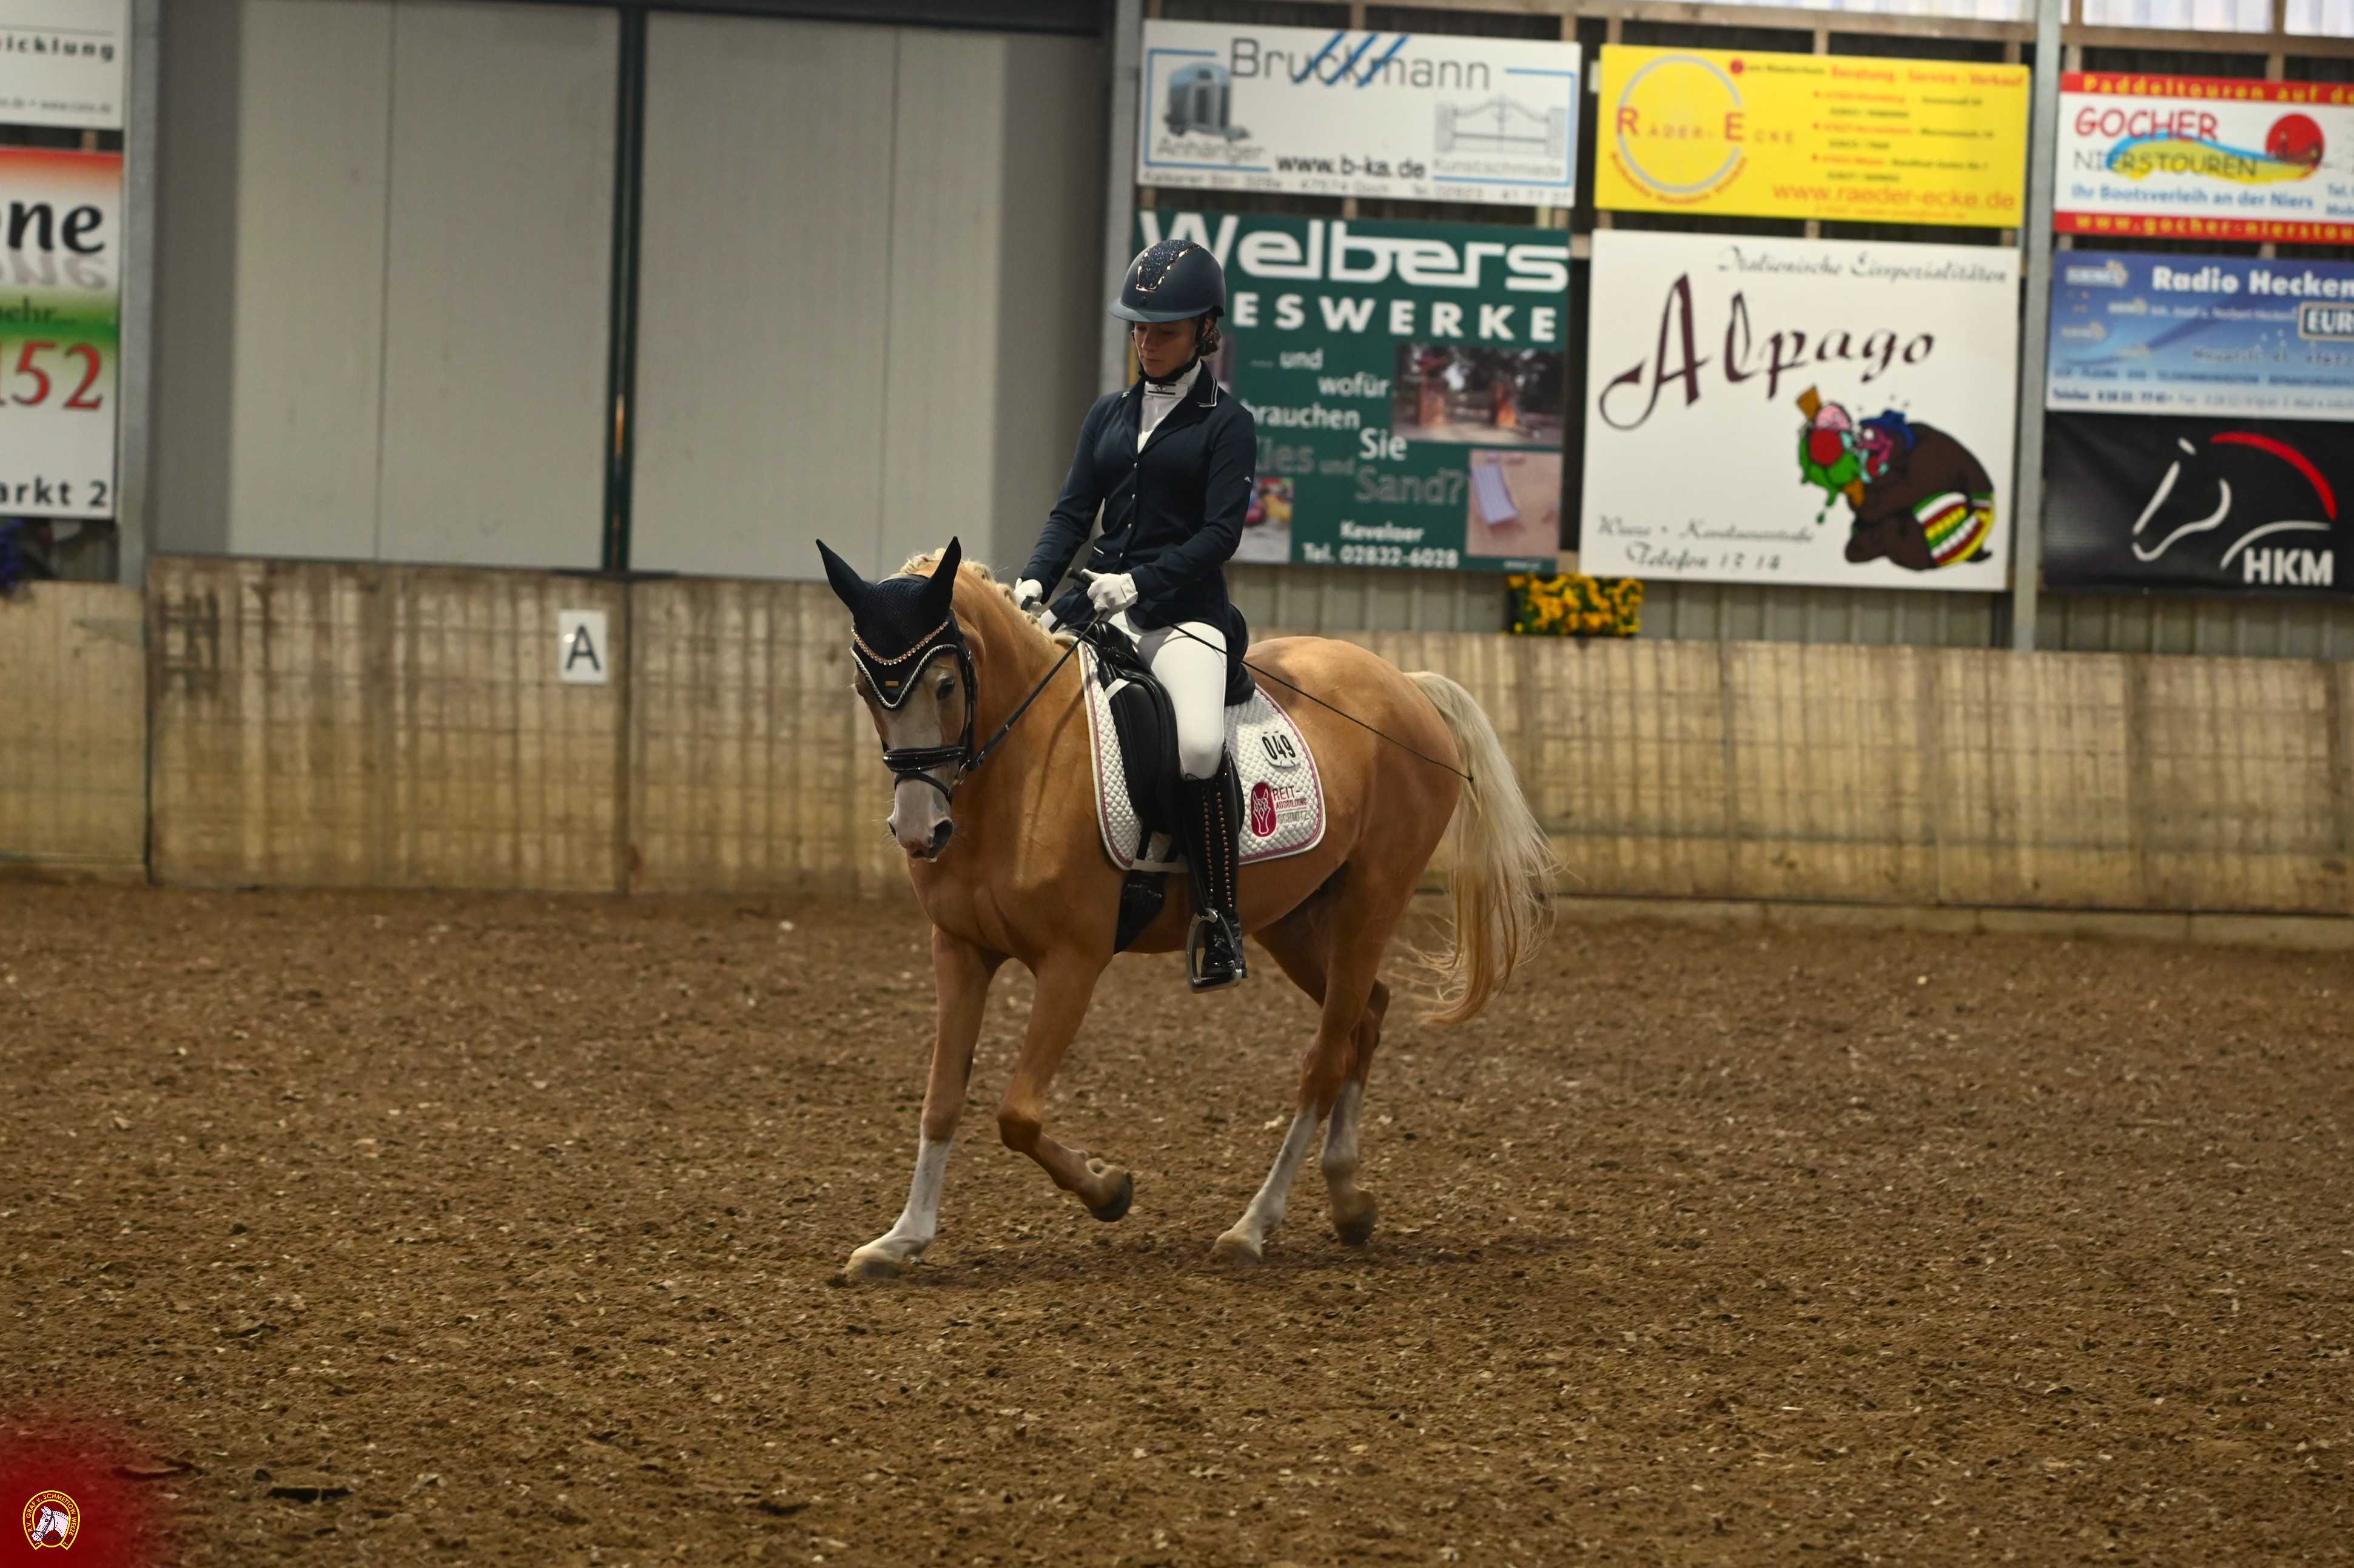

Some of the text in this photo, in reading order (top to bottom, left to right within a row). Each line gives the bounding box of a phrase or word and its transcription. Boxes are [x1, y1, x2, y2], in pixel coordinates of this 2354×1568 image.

[0, 35, 114, 62] icklung
[2074, 106, 2218, 141] GOCHER
[0, 198, 105, 255] ne
[1139, 210, 1570, 294] Welbers
[2152, 265, 2240, 295] Radio
[2249, 269, 2354, 298] Hecken
[1279, 347, 1323, 370] und
[1599, 270, 1936, 429] Alpago
[0, 341, 104, 411] 52
[1317, 371, 1391, 398] wofür
[1240, 399, 1360, 430] rauchen
[1359, 426, 1408, 461] Sie
[89, 480, 108, 508] 2
[1354, 463, 1465, 506] Sand?
[2244, 547, 2335, 587] HKM
[565, 624, 600, 670] A
[1262, 735, 1297, 761] 049
[1273, 786, 1300, 801] REIT-
